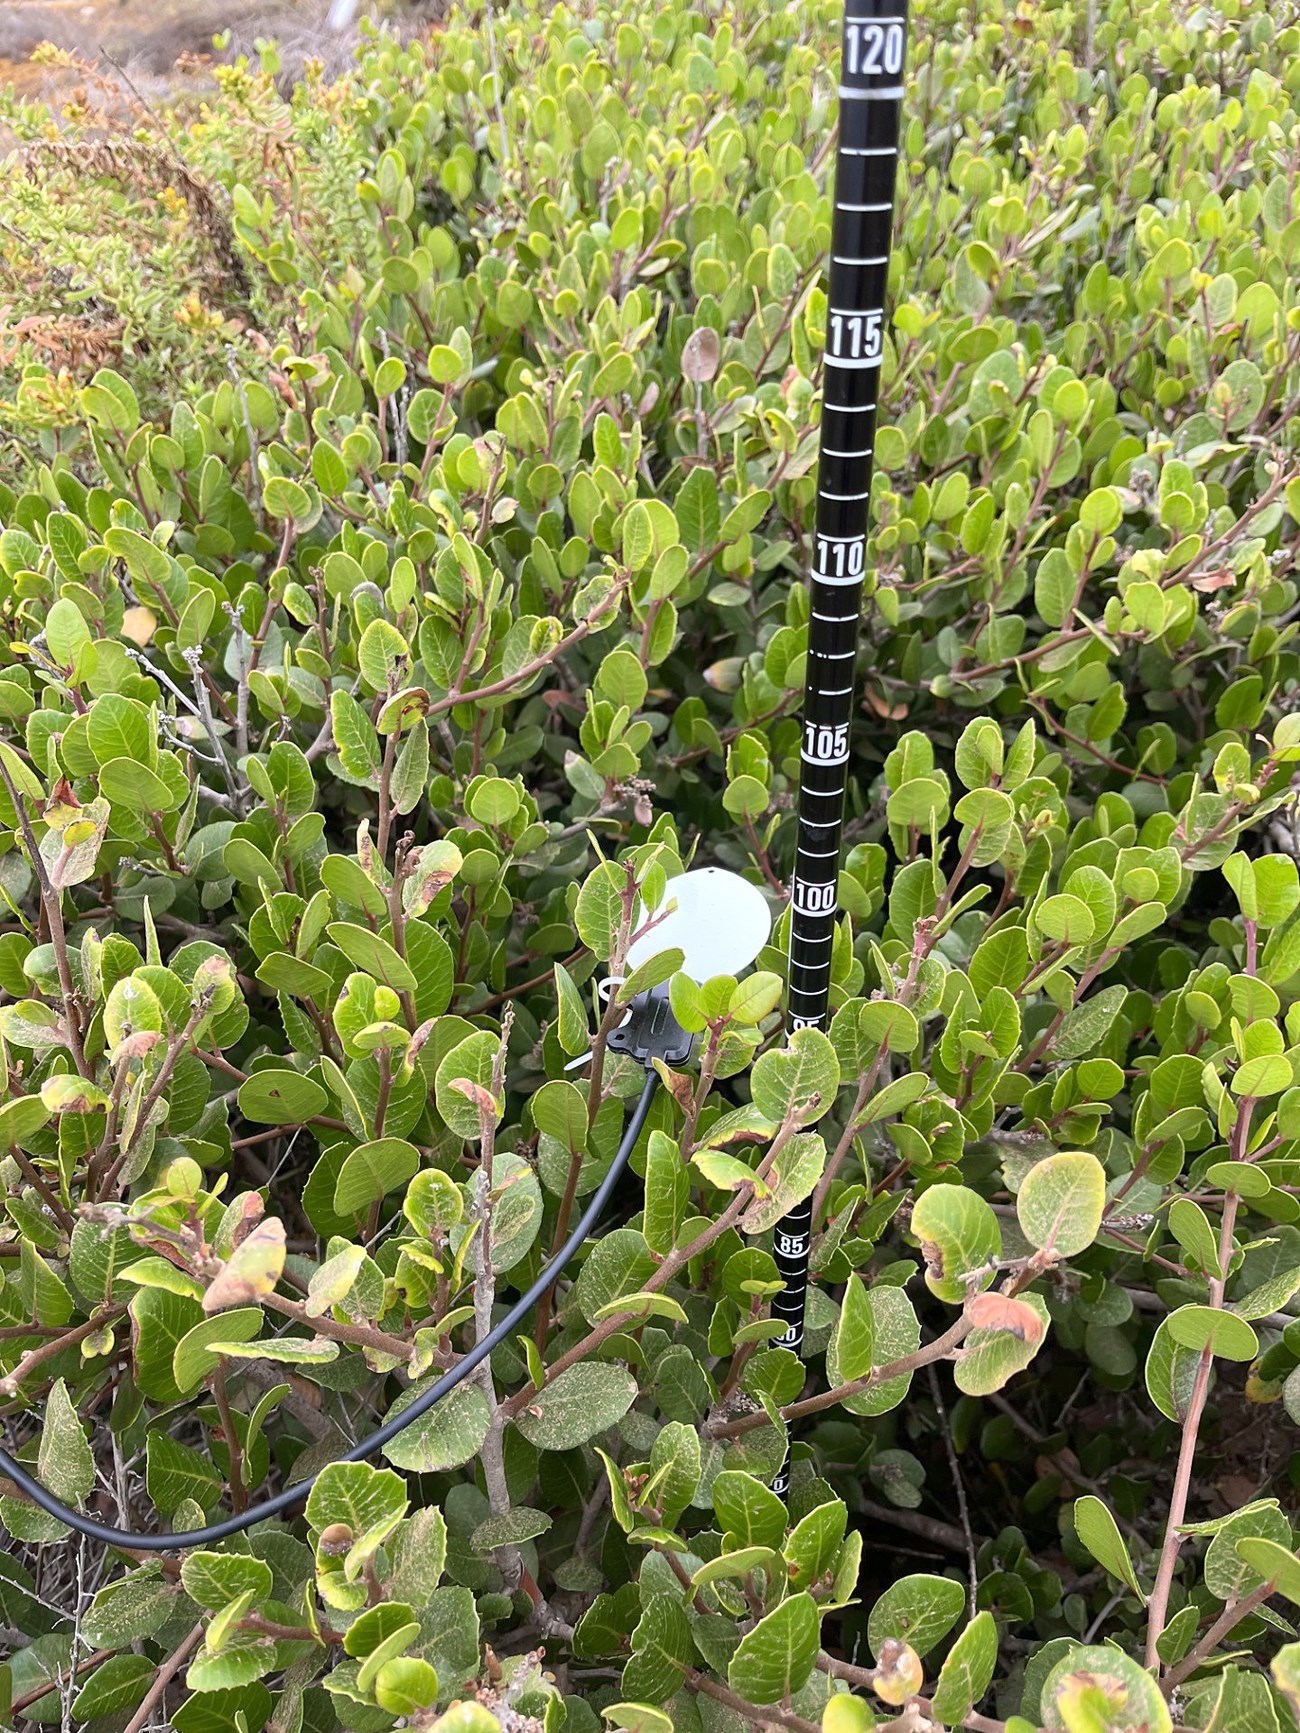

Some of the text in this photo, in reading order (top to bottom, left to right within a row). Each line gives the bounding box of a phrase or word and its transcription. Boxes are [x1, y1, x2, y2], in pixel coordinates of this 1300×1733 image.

[846, 24, 903, 75] 120
[831, 315, 882, 358] 115
[817, 540, 864, 577] 110
[806, 726, 848, 759] 105
[796, 883, 835, 911] 100
[780, 1236, 804, 1254] 85
